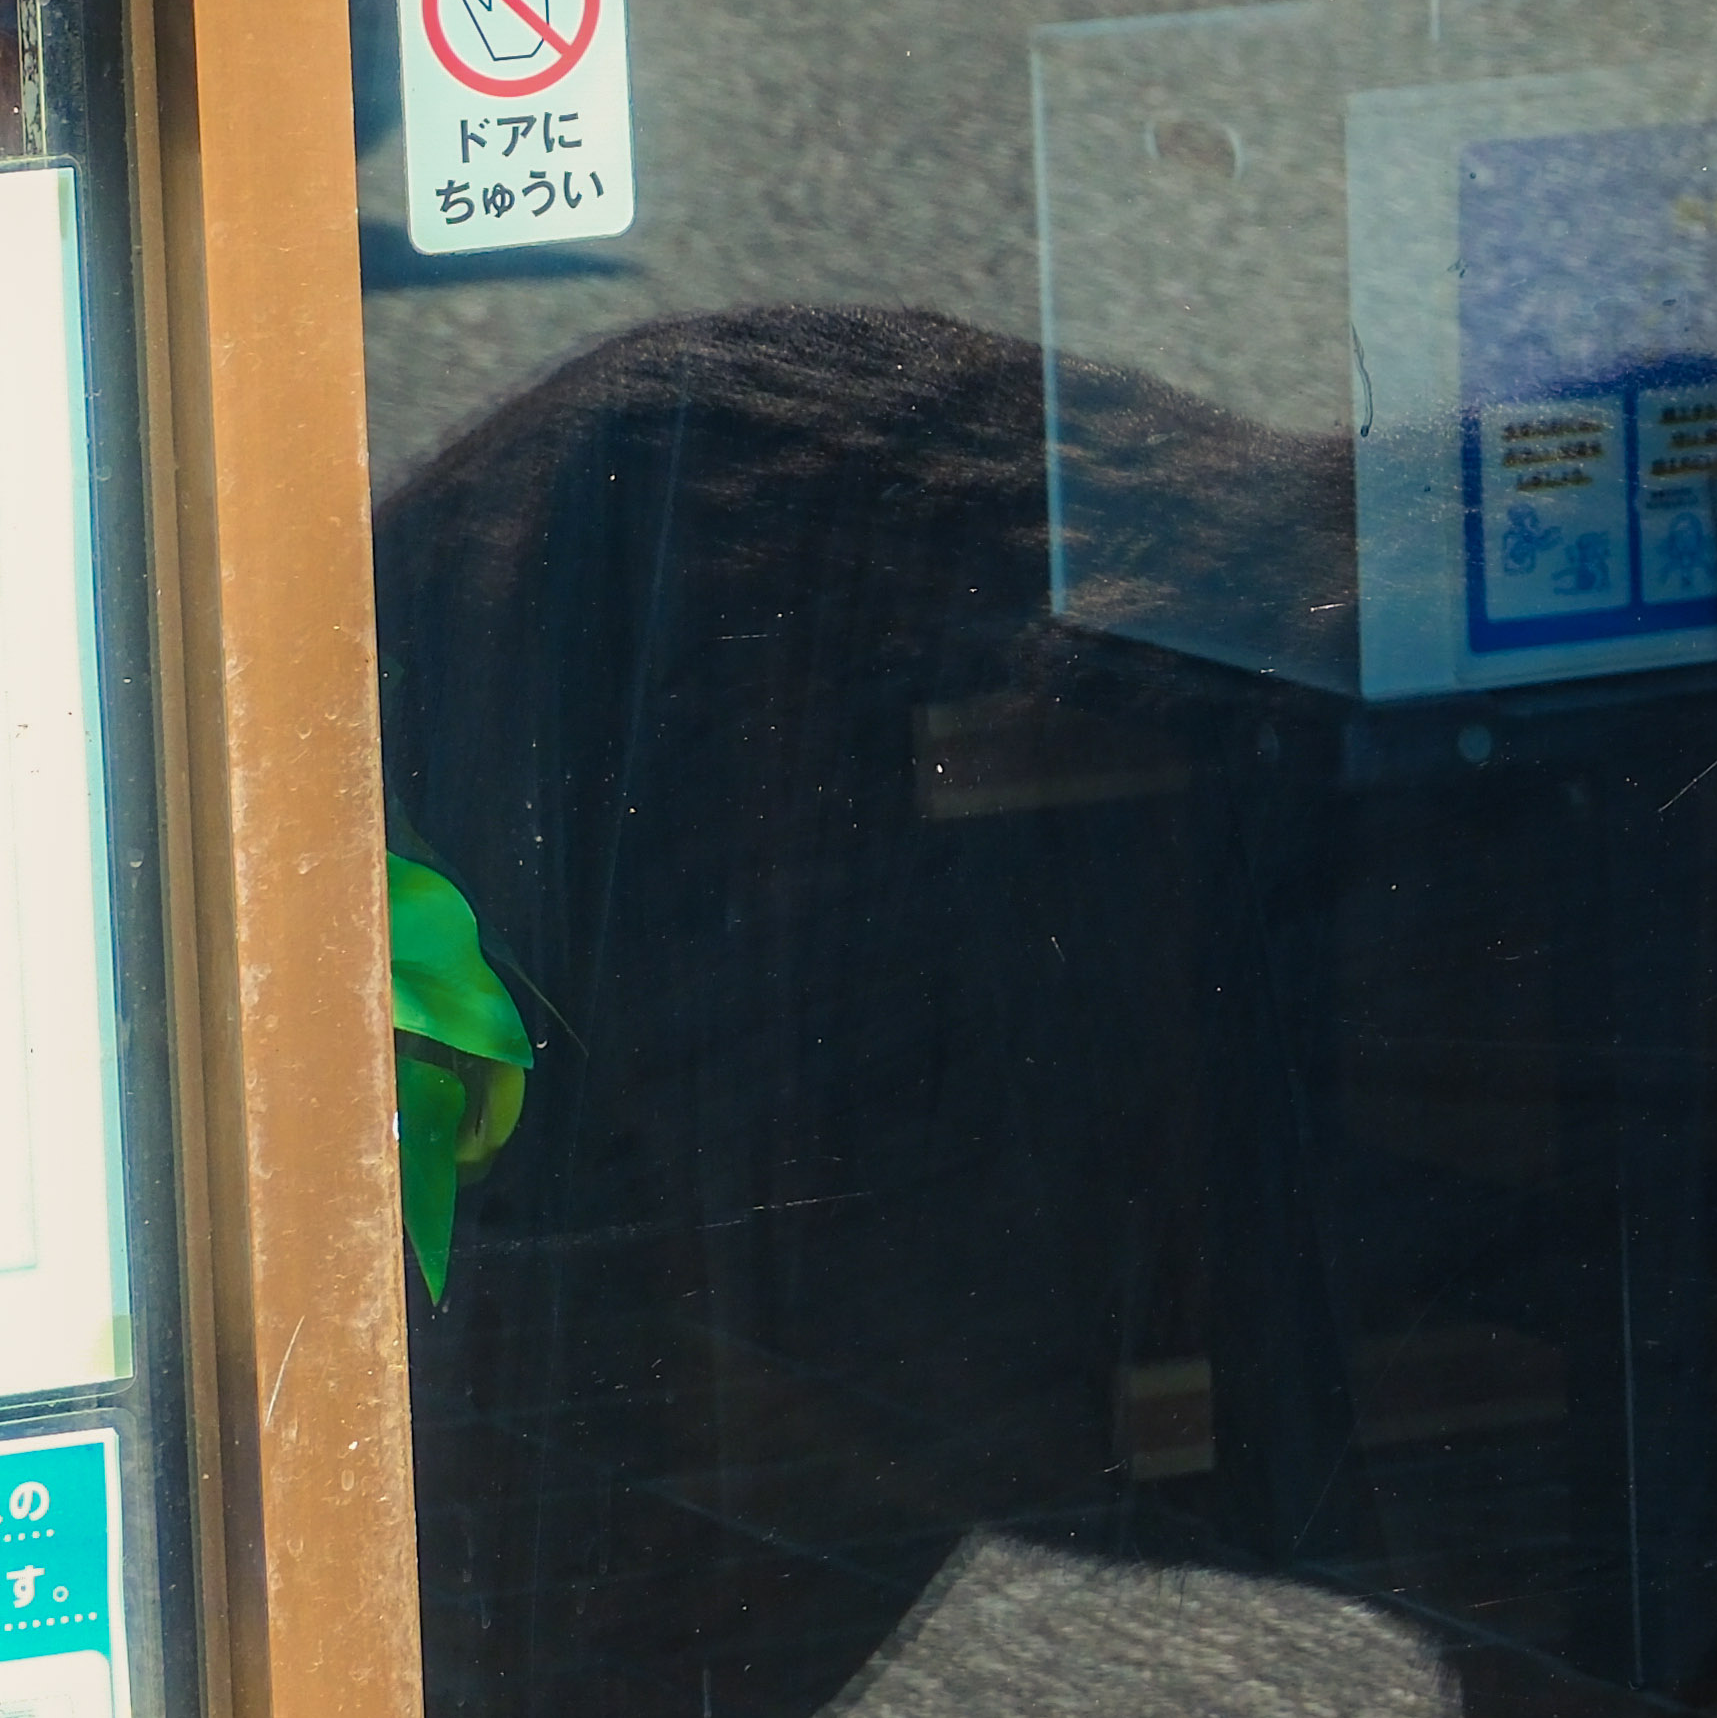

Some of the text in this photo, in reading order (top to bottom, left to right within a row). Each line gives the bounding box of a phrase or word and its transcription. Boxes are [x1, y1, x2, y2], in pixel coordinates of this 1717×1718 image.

[459, 112, 583, 164] ドアに
[434, 169, 605, 225] ちゅうい
